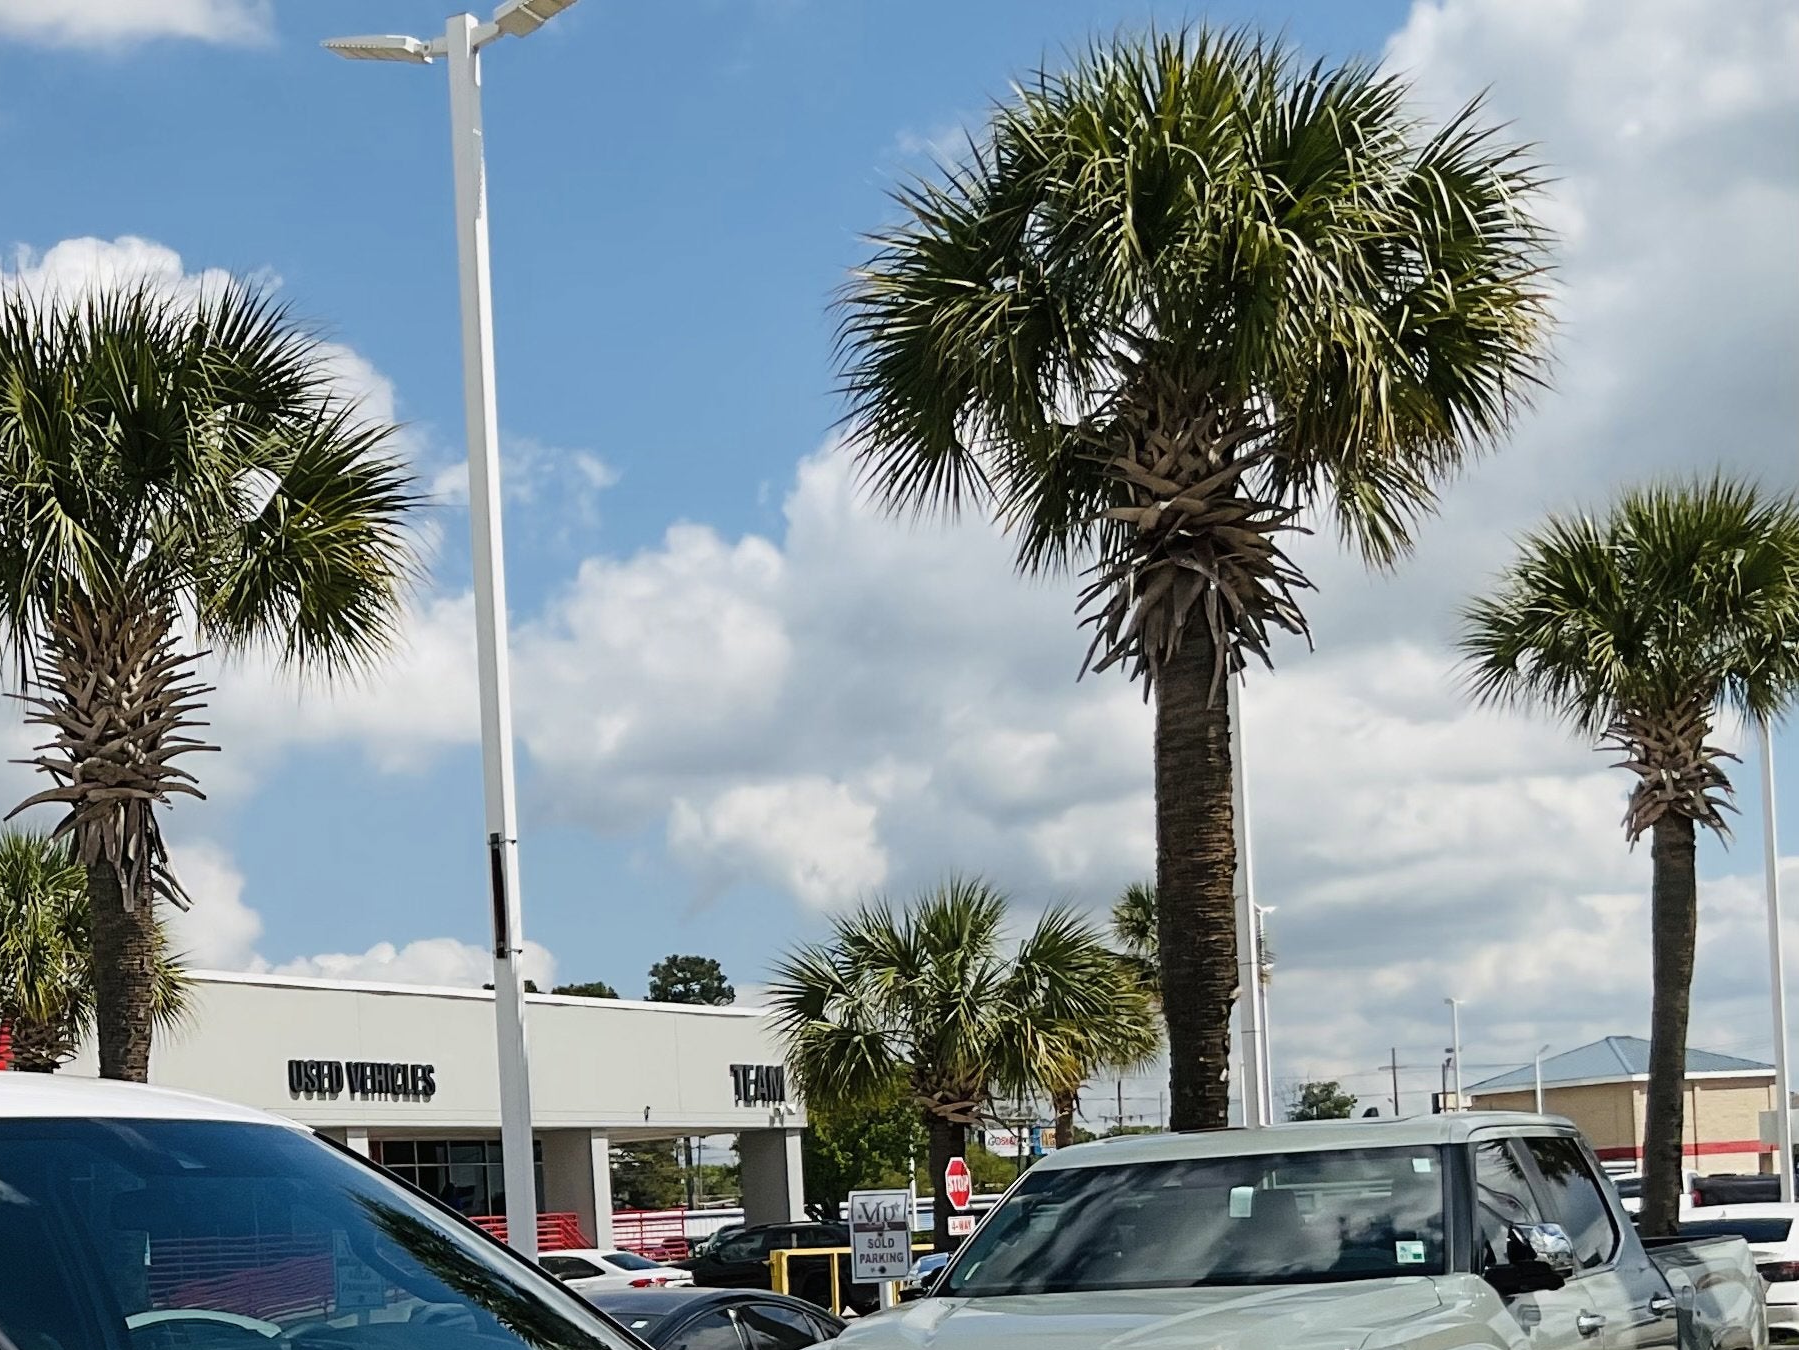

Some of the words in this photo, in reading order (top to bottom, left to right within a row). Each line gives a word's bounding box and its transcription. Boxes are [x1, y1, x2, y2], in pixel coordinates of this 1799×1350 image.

[288, 1060, 343, 1093] USED
[345, 1062, 436, 1095] VEHICLES
[730, 1064, 785, 1102] TEAM
[947, 1174, 969, 1193] STOP
[867, 1237, 895, 1249] SOLD
[859, 1252, 904, 1264] PARKING
